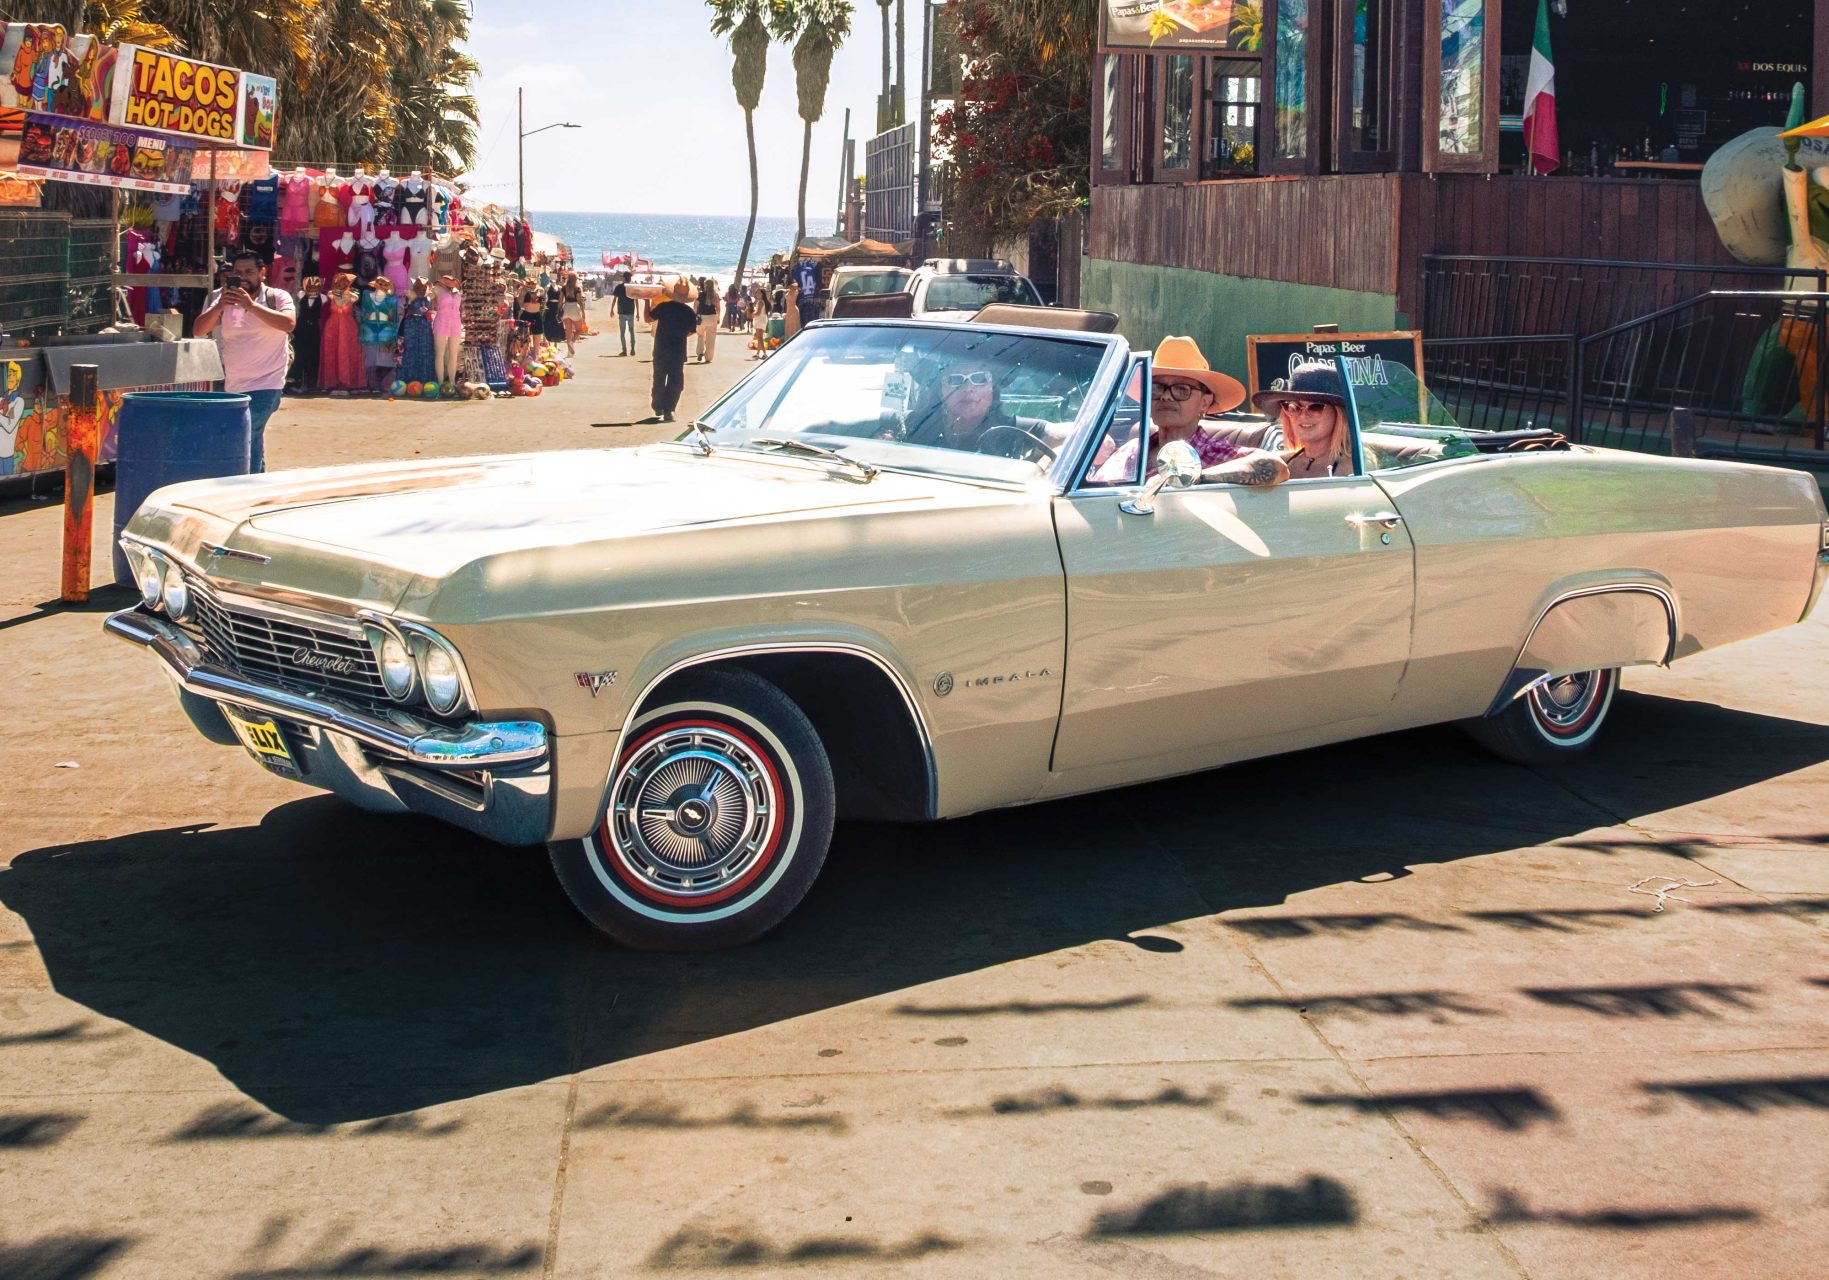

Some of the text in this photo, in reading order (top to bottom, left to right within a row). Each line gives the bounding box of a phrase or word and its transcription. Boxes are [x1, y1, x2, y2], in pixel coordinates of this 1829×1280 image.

[1111, 1, 1160, 17] Papas&Beer
[1753, 62, 1774, 72] DOS
[1777, 63, 1807, 73] EQUIS
[135, 50, 236, 110] TACOS
[127, 96, 234, 138] HOT DOGS
[113, 131, 136, 147] DOO
[137, 136, 167, 151] MENU
[1306, 342, 1366, 356] Papas&Beer
[292, 646, 353, 676] Chevrolet
